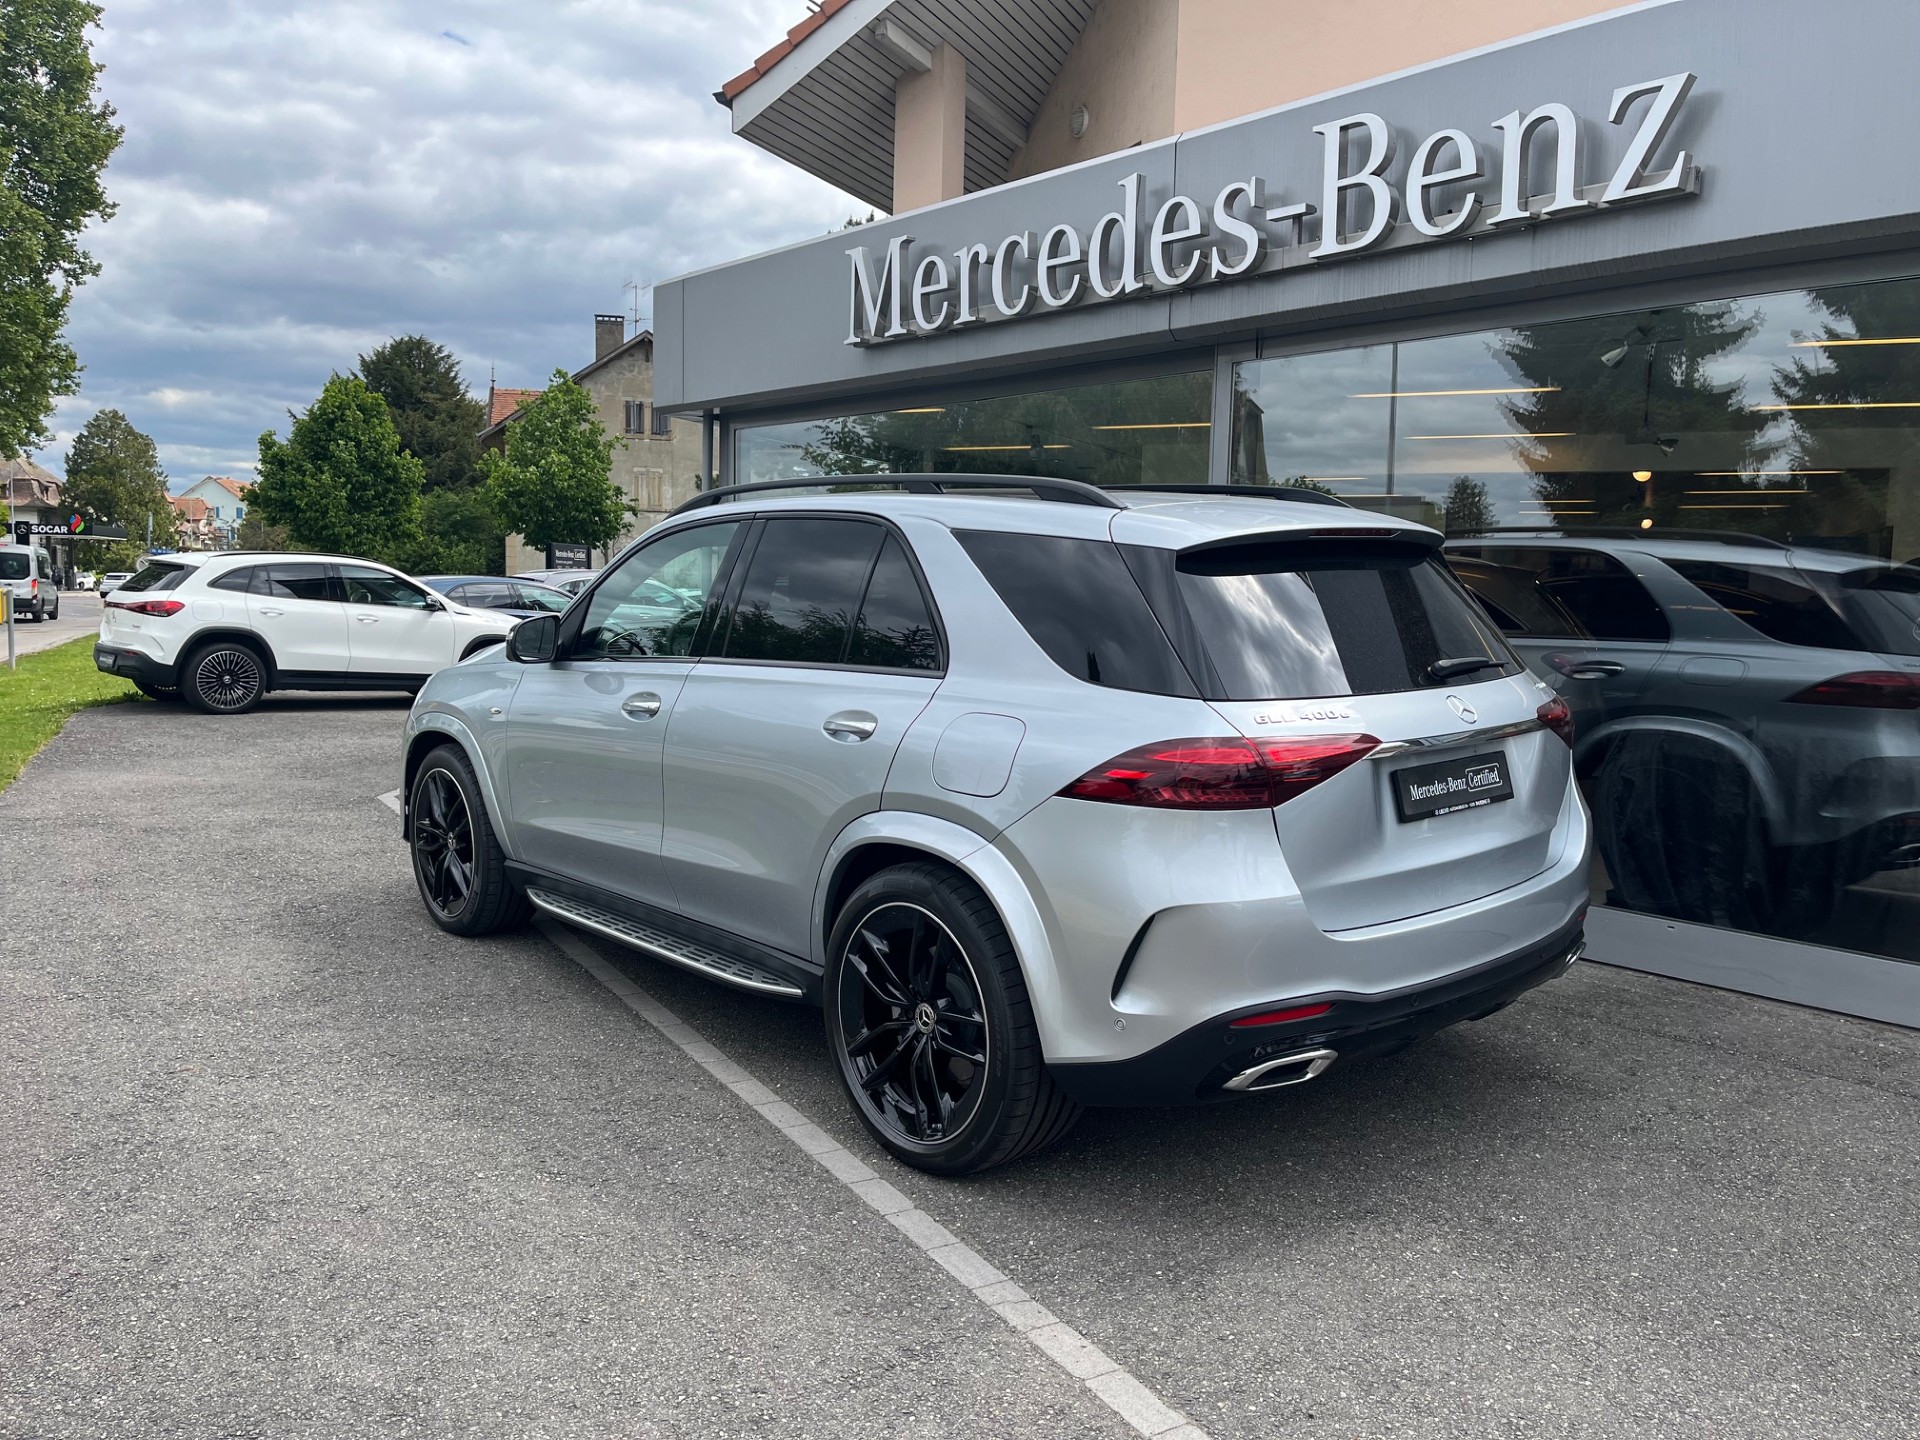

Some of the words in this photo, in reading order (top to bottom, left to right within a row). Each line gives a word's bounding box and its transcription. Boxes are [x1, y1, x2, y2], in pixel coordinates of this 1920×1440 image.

[844, 71, 1699, 346] Mercedes-Benz
[31, 525, 68, 534] SOCAR
[1409, 777, 1467, 801] Mercedes-Benz
[1468, 767, 1500, 787] Certified
